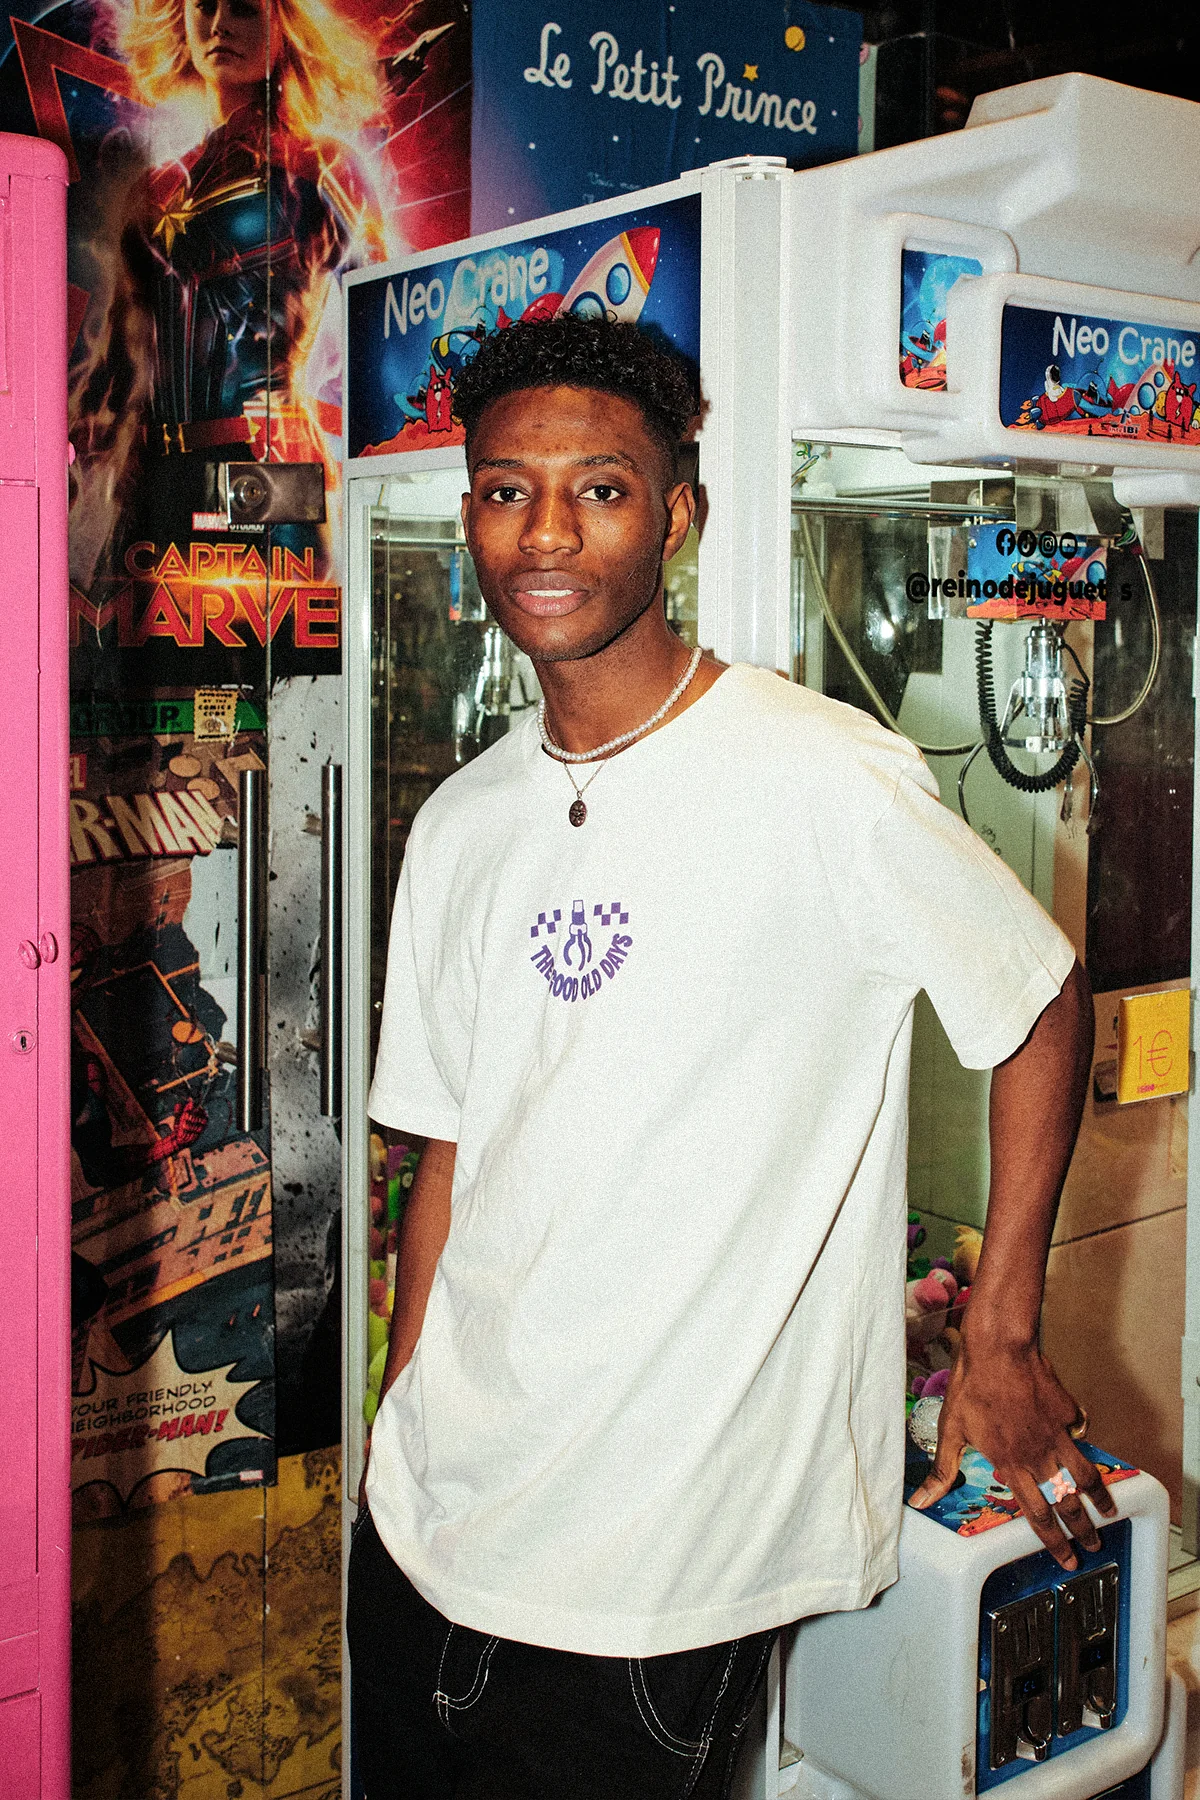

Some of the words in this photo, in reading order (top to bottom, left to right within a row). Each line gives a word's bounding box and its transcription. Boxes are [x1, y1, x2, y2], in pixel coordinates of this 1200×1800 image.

[524, 22, 573, 89] Le
[589, 31, 682, 109] Petit
[696, 52, 817, 135] Prince
[384, 277, 445, 339] Neo
[452, 247, 549, 308] Crane
[1052, 316, 1109, 358] Neo
[1118, 327, 1197, 367] Crane
[124, 540, 314, 581] CAPTAIN
[906, 569, 1133, 606] @reinodejuguets
[69, 580, 341, 648] MARVE
[70, 789, 224, 866] R-MAN
[581, 968, 602, 1000] OLD
[599, 933, 633, 980] DAYS
[1133, 1029, 1173, 1080] 1€
[126, 1381, 213, 1407] FRIENDLY
[71, 1408, 230, 1460] PIDER-MAN!
